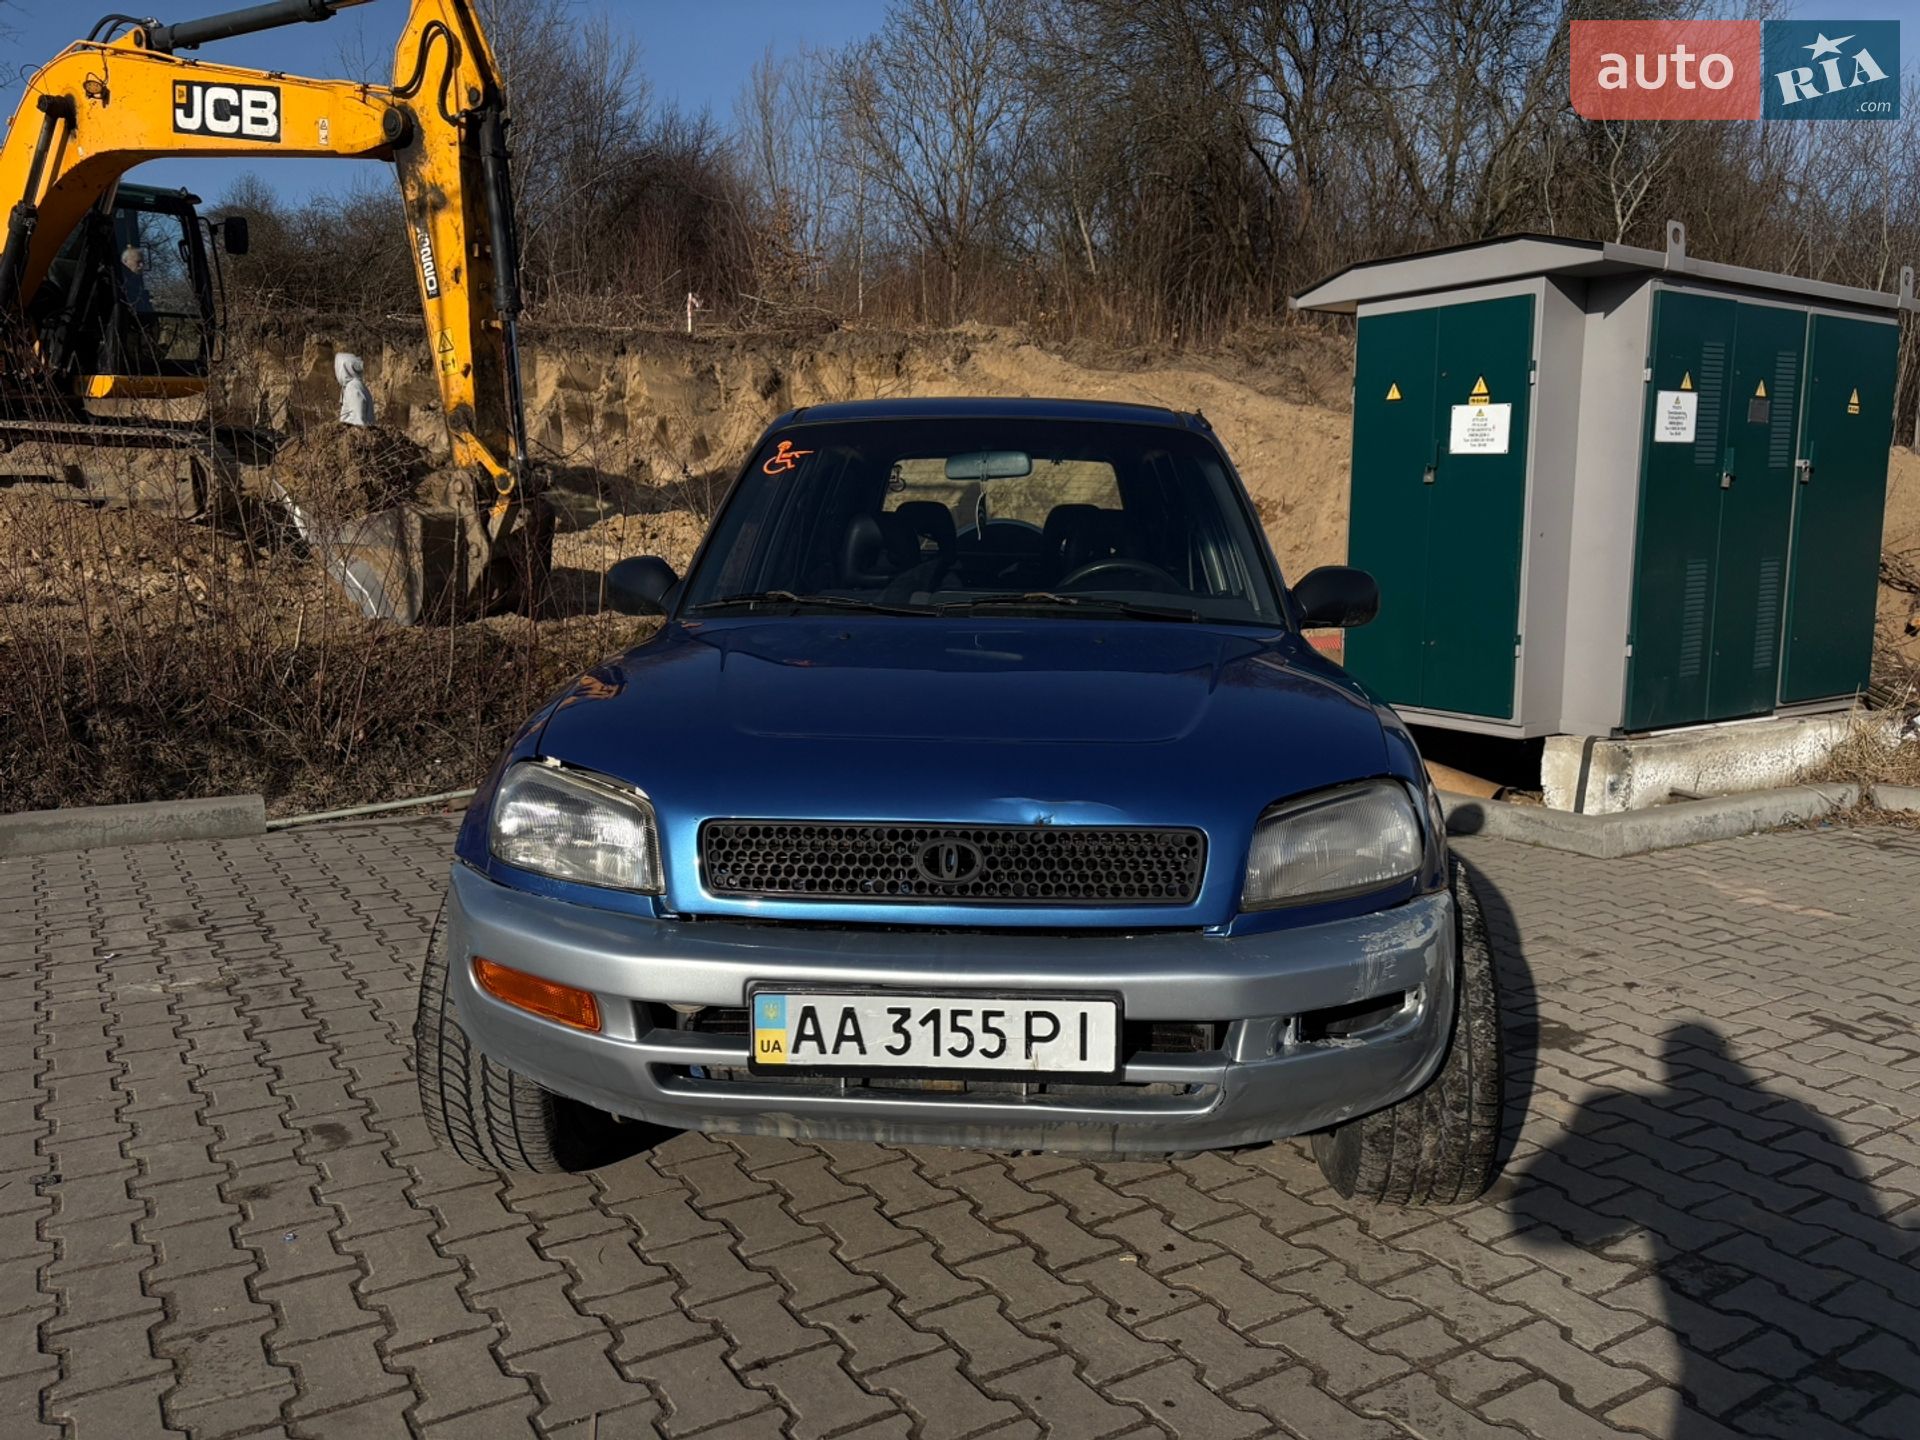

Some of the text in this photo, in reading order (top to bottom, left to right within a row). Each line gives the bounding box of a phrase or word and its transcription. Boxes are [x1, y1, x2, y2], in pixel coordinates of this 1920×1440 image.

[175, 85, 279, 137] JCB
[415, 227, 437, 291] S220
[760, 1039, 783, 1054] UA
[791, 1005, 867, 1056] AA
[884, 1007, 1008, 1060] 3155
